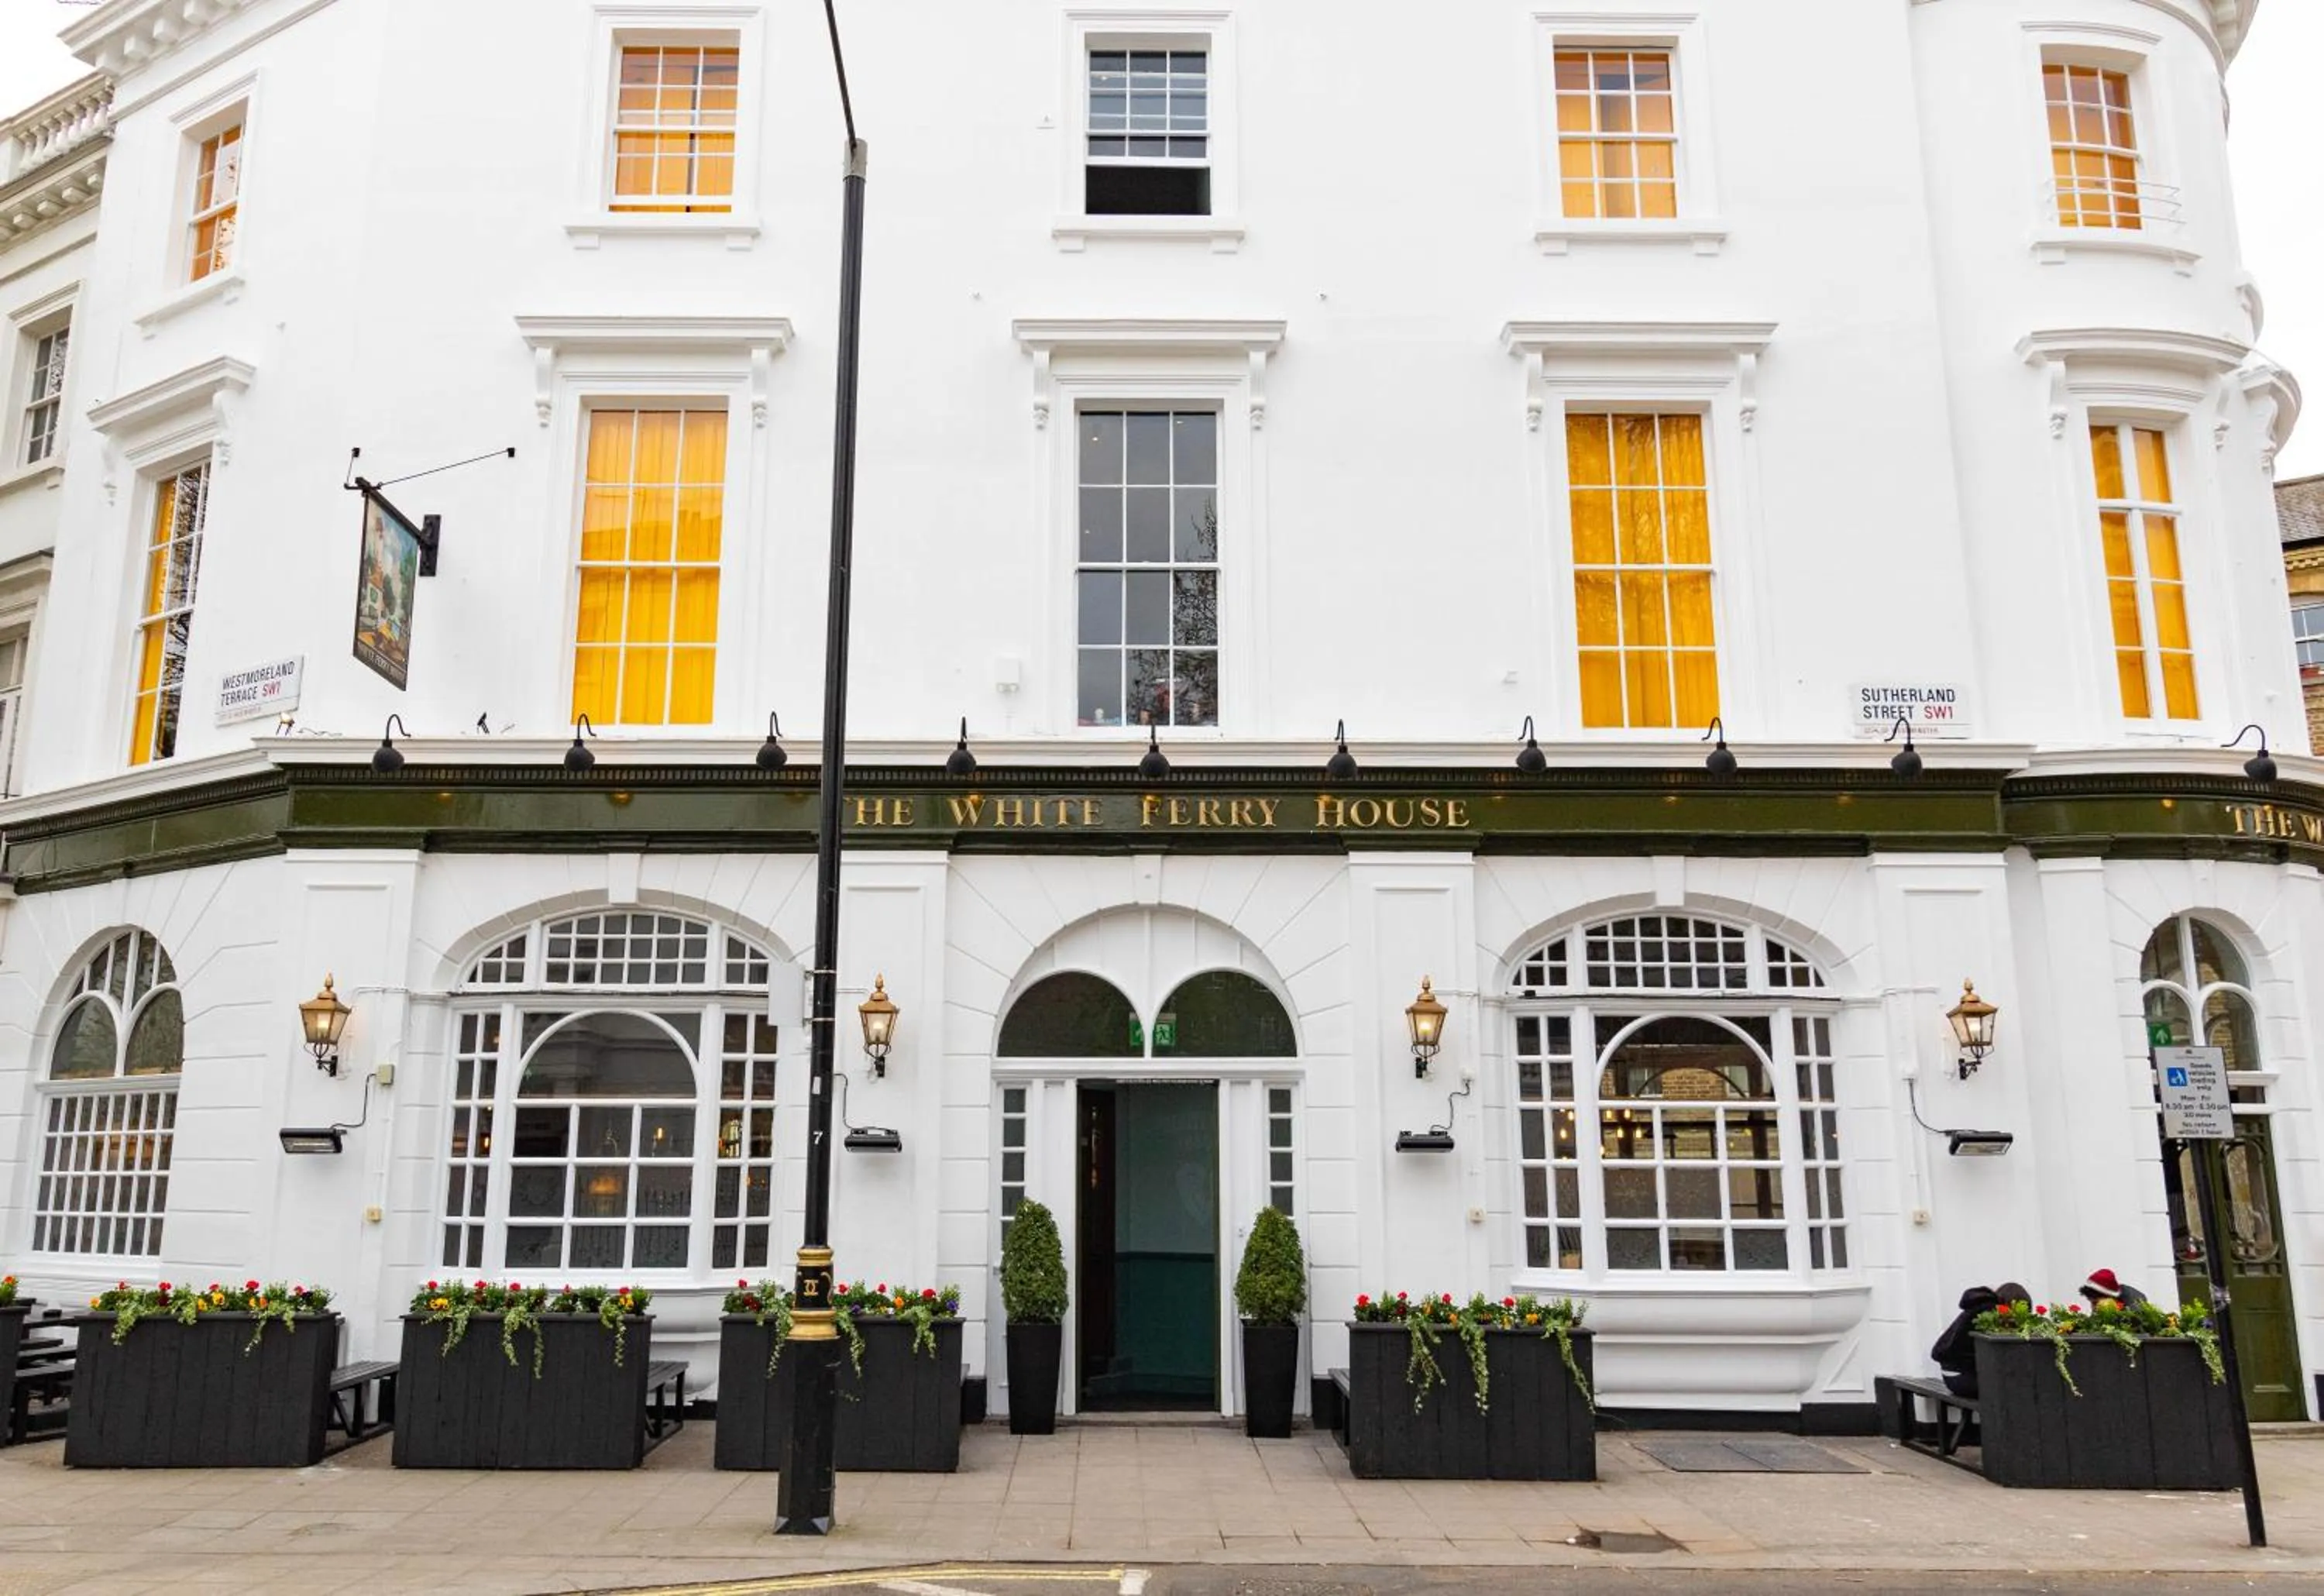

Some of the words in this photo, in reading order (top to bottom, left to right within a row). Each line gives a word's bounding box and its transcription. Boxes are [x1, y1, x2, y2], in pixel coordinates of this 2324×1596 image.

[222, 661, 294, 690] WESTMORELAND
[221, 686, 257, 707] TERRACE
[1862, 688, 1956, 703] SUTHERLAND
[1863, 706, 1913, 719] STREET
[1924, 706, 1953, 719] SW1
[843, 796, 915, 826] HE
[947, 797, 1104, 827] WHITE
[1140, 797, 1281, 827] FERRY
[1315, 797, 1470, 827] HOUSE
[2226, 805, 2296, 837] THE
[813, 1131, 823, 1144] 7
